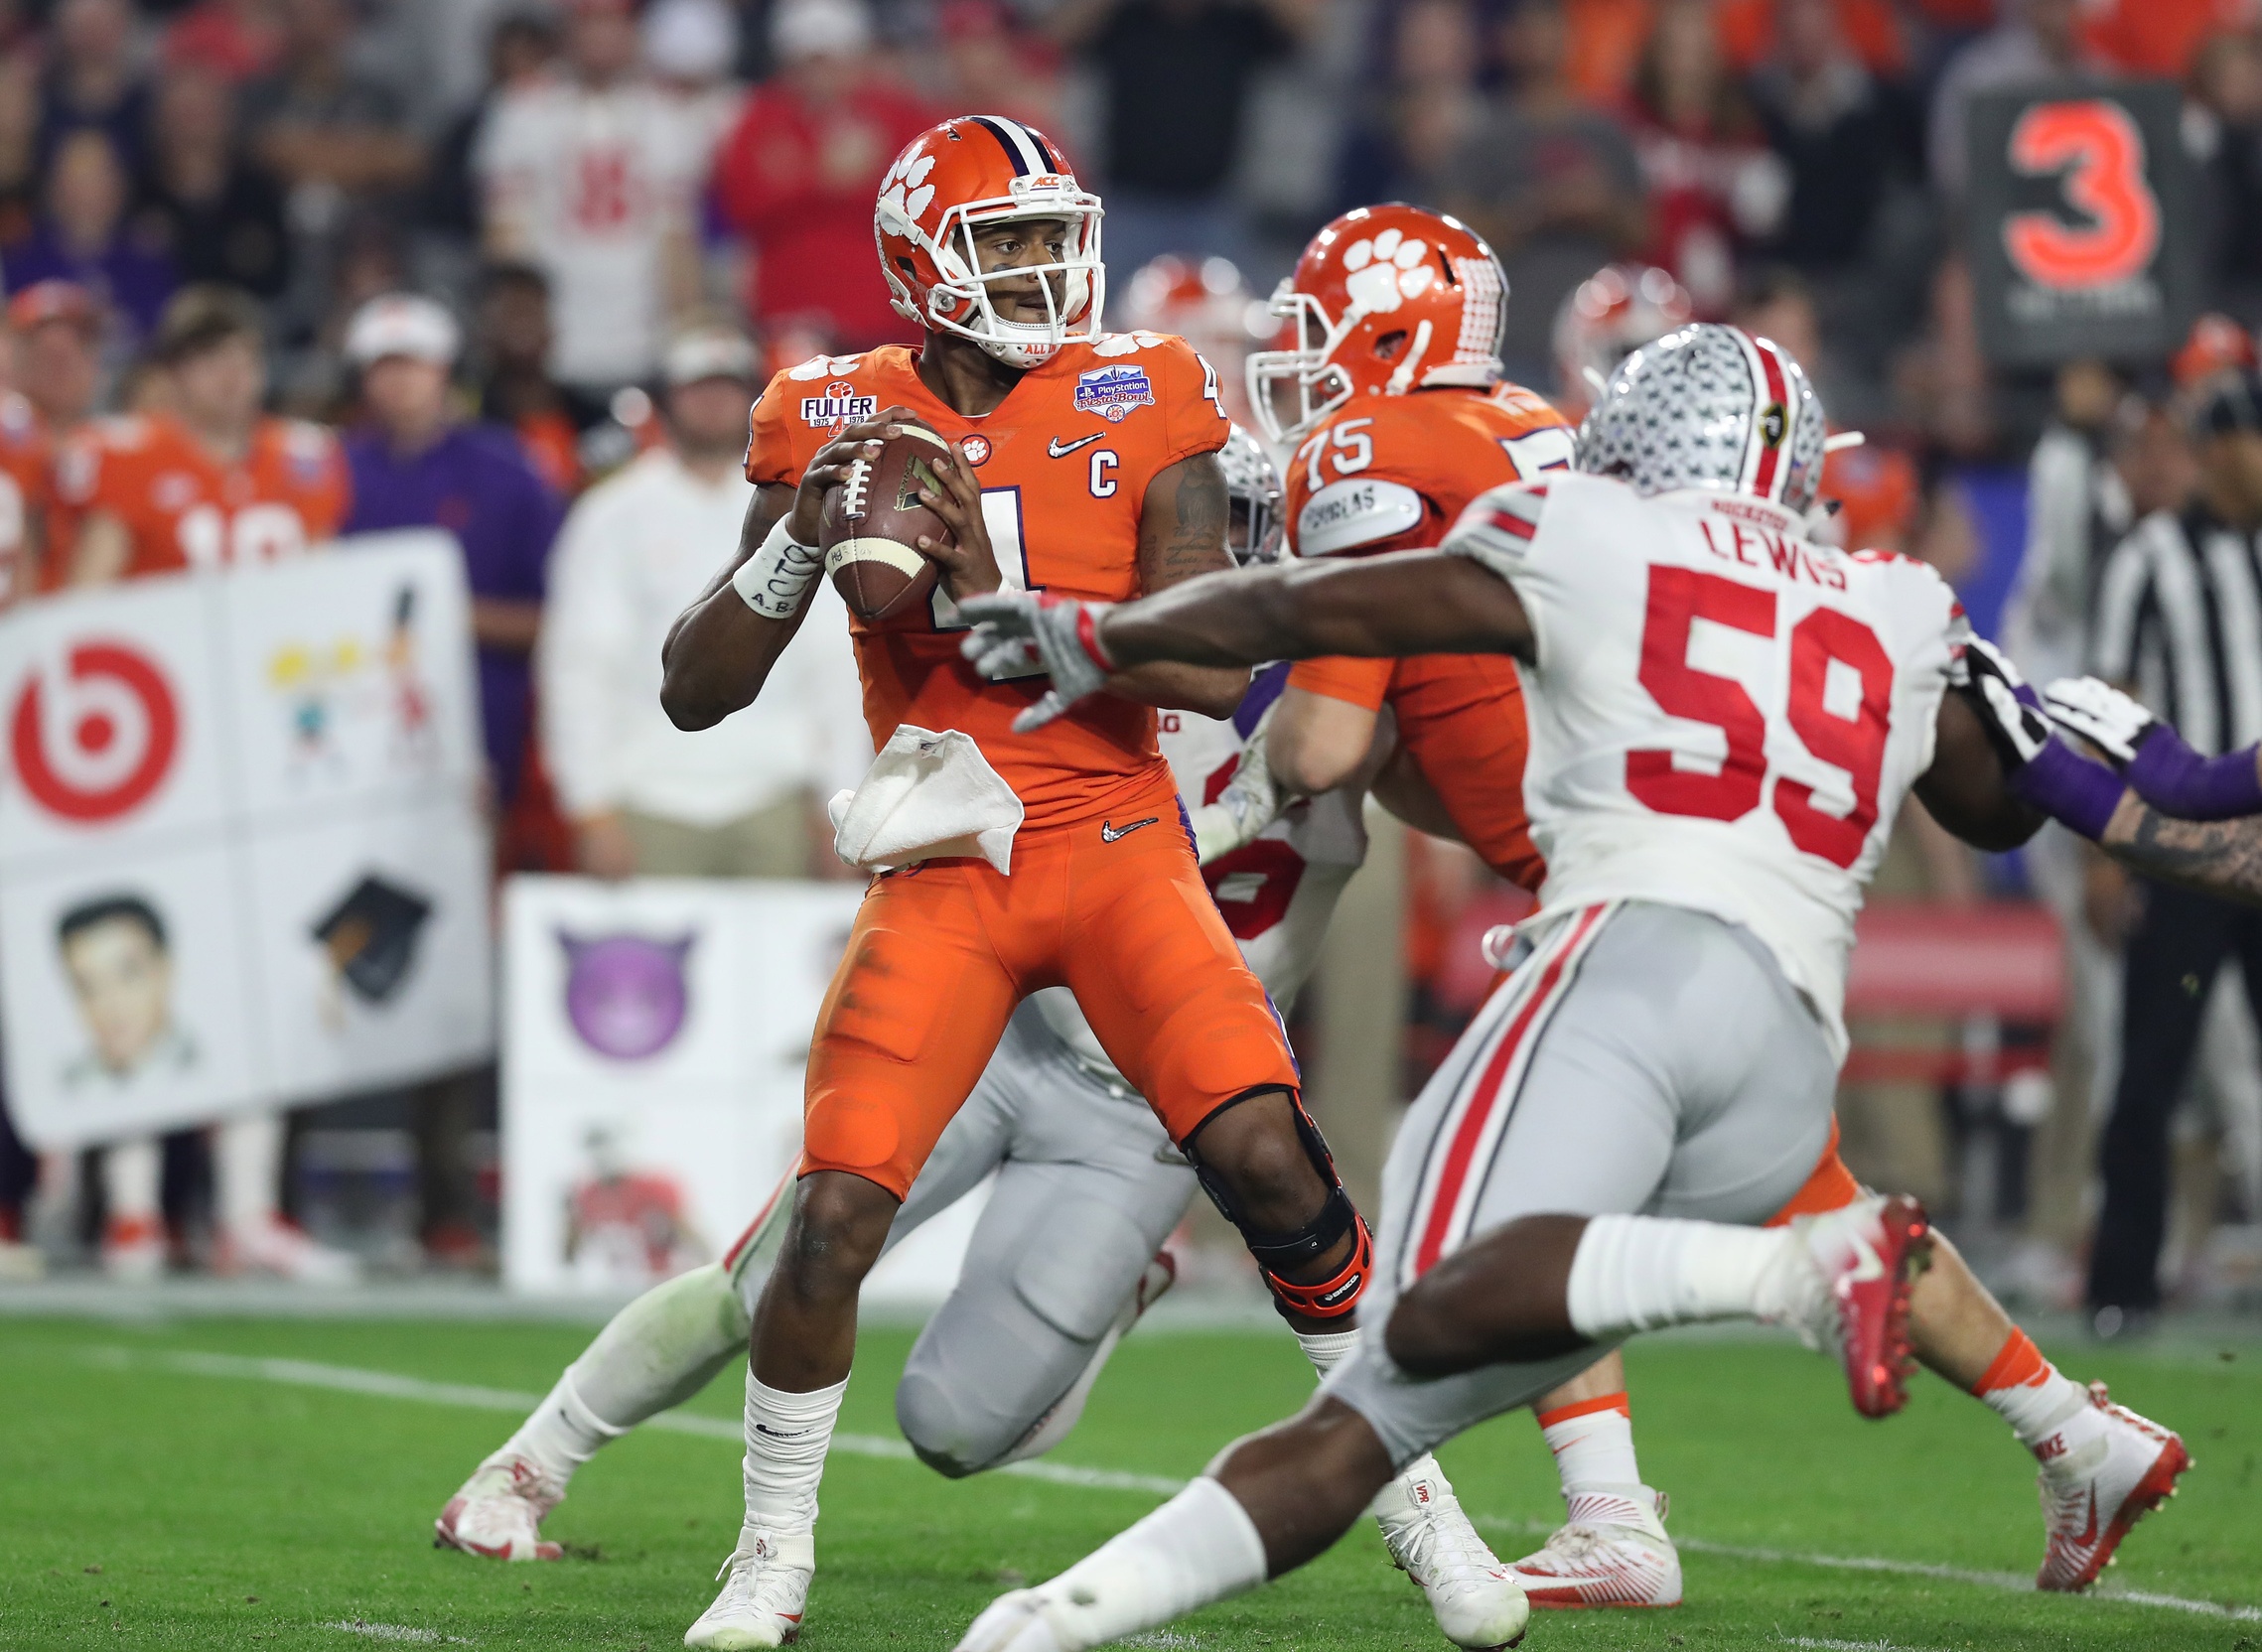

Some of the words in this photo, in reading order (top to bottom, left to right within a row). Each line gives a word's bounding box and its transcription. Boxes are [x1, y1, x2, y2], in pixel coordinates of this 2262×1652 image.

[1032, 176, 1060, 187] ACC
[2004, 98, 2163, 290] 3
[1024, 344, 1046, 354] ALL
[1097, 381, 1148, 395] PlayStation
[804, 397, 873, 419] FULLER
[1077, 395, 1115, 408] Fiesta
[1115, 392, 1150, 402] Bowl
[813, 418, 829, 427] 1975
[849, 415, 865, 424] 1978
[1297, 417, 1373, 492] 75
[1089, 449, 1120, 498] C
[1699, 518, 1847, 592] LEWIS
[1625, 562, 1896, 872] 59
[1416, 1484, 1430, 1503] VPR
